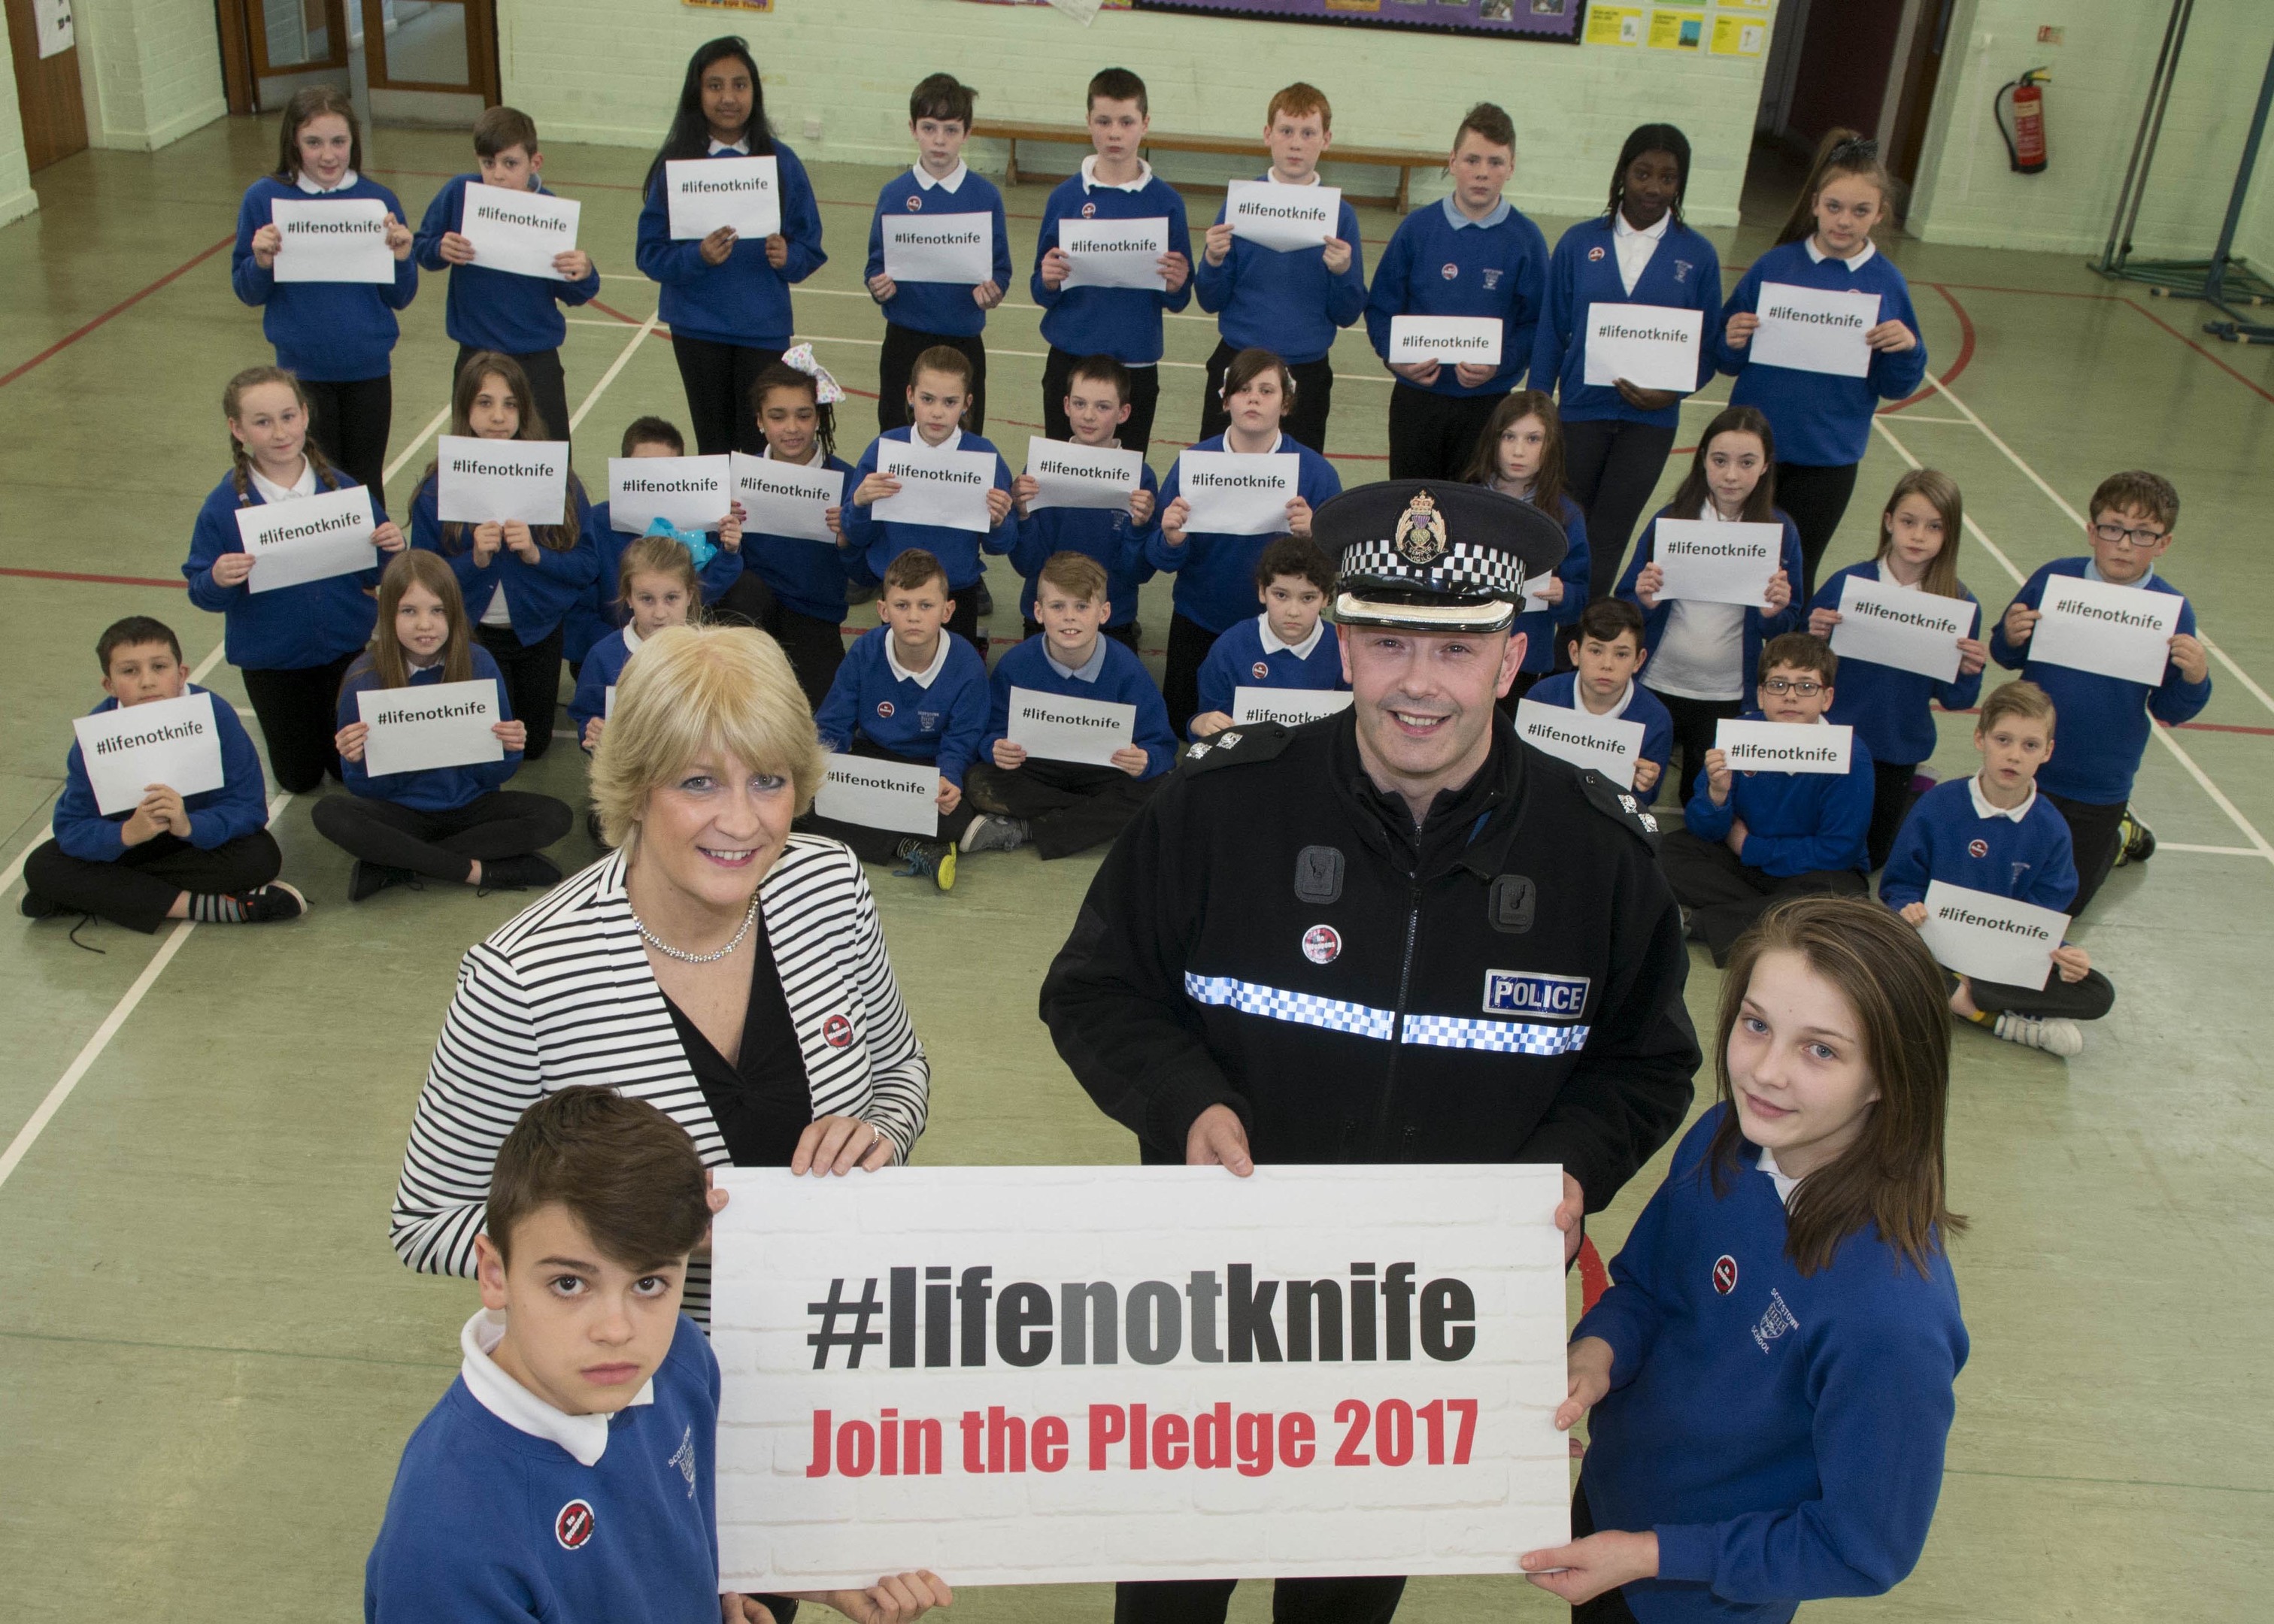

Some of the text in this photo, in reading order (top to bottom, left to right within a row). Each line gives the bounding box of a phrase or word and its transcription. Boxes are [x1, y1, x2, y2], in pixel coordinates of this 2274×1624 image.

[682, 177, 768, 193] #lifenotknife
[478, 207, 567, 231] #lifenotknife
[1239, 202, 1326, 221] #lifenotknife
[288, 220, 381, 233] #lifenotknife
[895, 232, 981, 244] #lifenotknife
[1072, 239, 1157, 253] #lifenotknife
[1769, 306, 1863, 328] #lifenotknife
[1402, 335, 1489, 348] #lifenotknife
[1599, 325, 1688, 343] #lifenotknife
[453, 459, 554, 477] #lifenotknife
[888, 463, 981, 485] #lifenotknife
[1040, 460, 1130, 481] #lifenotknife
[622, 477, 718, 492] #lifenotknife
[740, 477, 830, 501] #lifenotknife
[1192, 473, 1286, 489] #lifenotknife
[259, 512, 361, 545] #lifenotknife
[1668, 541, 1766, 558] #lifenotknife
[1855, 601, 1957, 634] #lifenotknife
[2057, 600, 2162, 630] #lifenotknife
[377, 701, 486, 725] #lifenotknife
[1023, 707, 1120, 729] #lifenotknife
[96, 720, 203, 755] #lifenotknife
[1528, 723, 1626, 755] #lifenotknife
[1731, 744, 1837, 762] #lifenotknife
[827, 771, 926, 795] #lifenotknife
[1939, 907, 2049, 941] #lifenotknife
[1494, 980, 1583, 1010] POLICE
[806, 1262, 1476, 1370] #lifenotknife
[1751, 1324, 1770, 1355] SCHOOL
[805, 1398, 1478, 1478] Join the Pledge 2017
